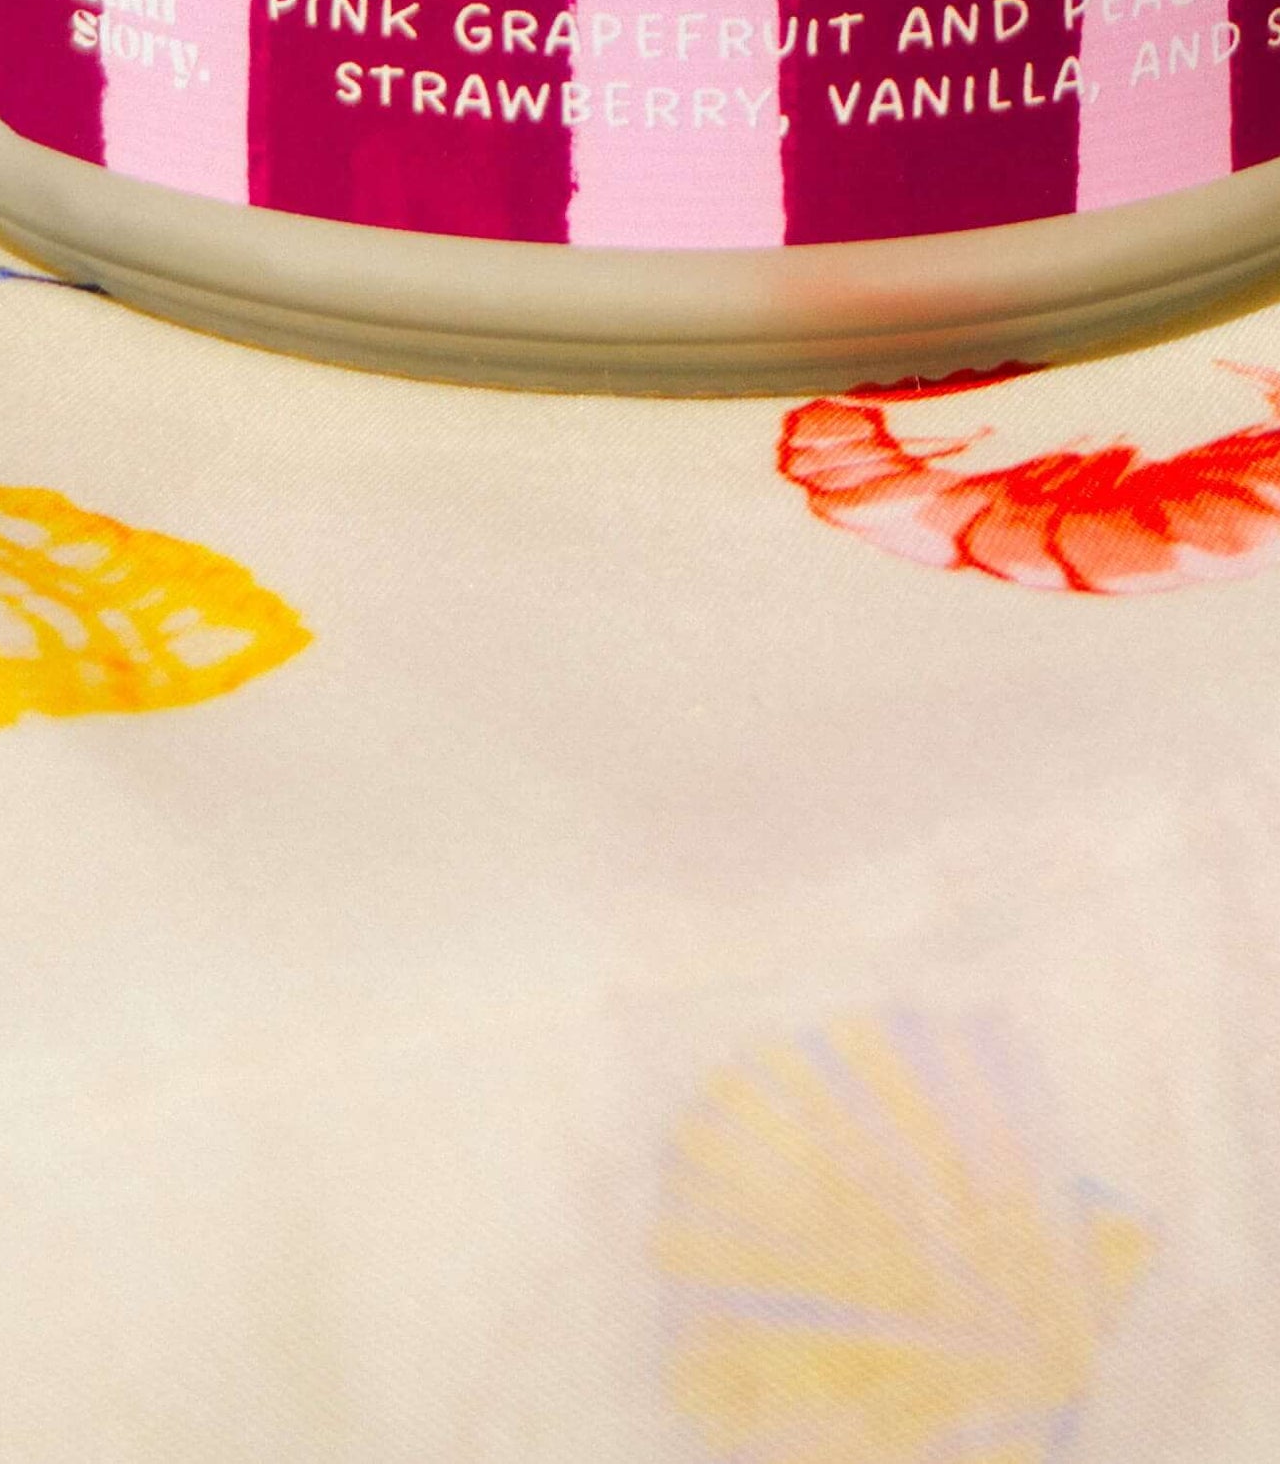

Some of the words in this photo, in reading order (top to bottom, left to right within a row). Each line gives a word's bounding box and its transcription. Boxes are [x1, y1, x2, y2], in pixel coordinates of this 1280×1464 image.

[71, 8, 210, 89] story.
[454, 2, 863, 60] GRAPEFRUIT
[335, 61, 791, 136] STRAWBERRY,
[827, 56, 1101, 125] VANILLA,
[1131, 21, 1241, 86] AND
